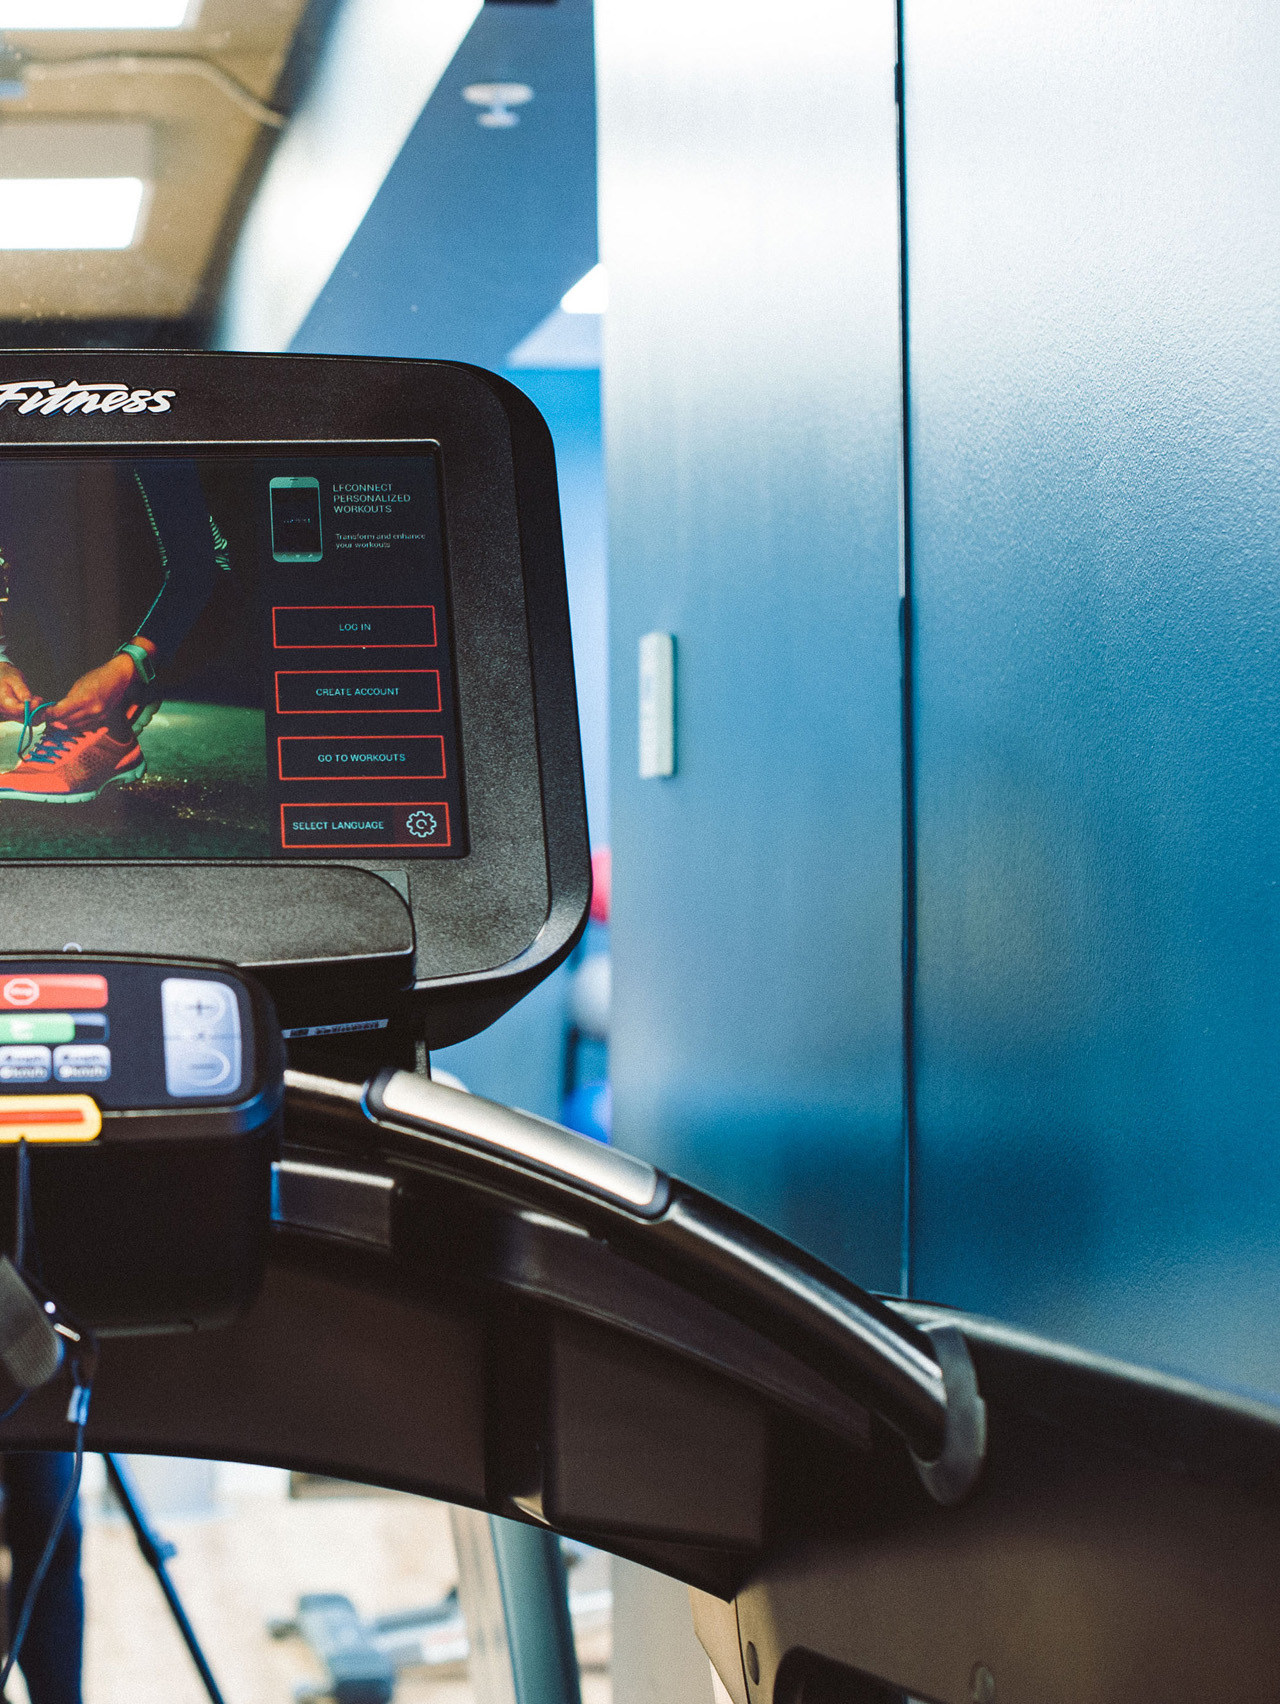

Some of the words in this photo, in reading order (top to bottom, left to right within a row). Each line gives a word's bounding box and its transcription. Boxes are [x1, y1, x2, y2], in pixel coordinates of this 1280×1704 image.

[332, 483, 393, 492] LFCONNECT
[333, 494, 411, 503] PERSONALIZED
[333, 504, 393, 514] WORKOUTS
[393, 532, 426, 540] enhance
[335, 542, 353, 550] your
[354, 541, 391, 549] workouts
[339, 623, 358, 632] LOG
[360, 623, 372, 631] IN
[315, 688, 353, 697] CREATE
[354, 687, 400, 696] ACCOUNT
[317, 754, 334, 762] GO
[335, 754, 348, 762] TO
[350, 753, 406, 762] WORKOUTS
[292, 821, 329, 830] SELECT
[331, 821, 385, 830] LANGUAGE
